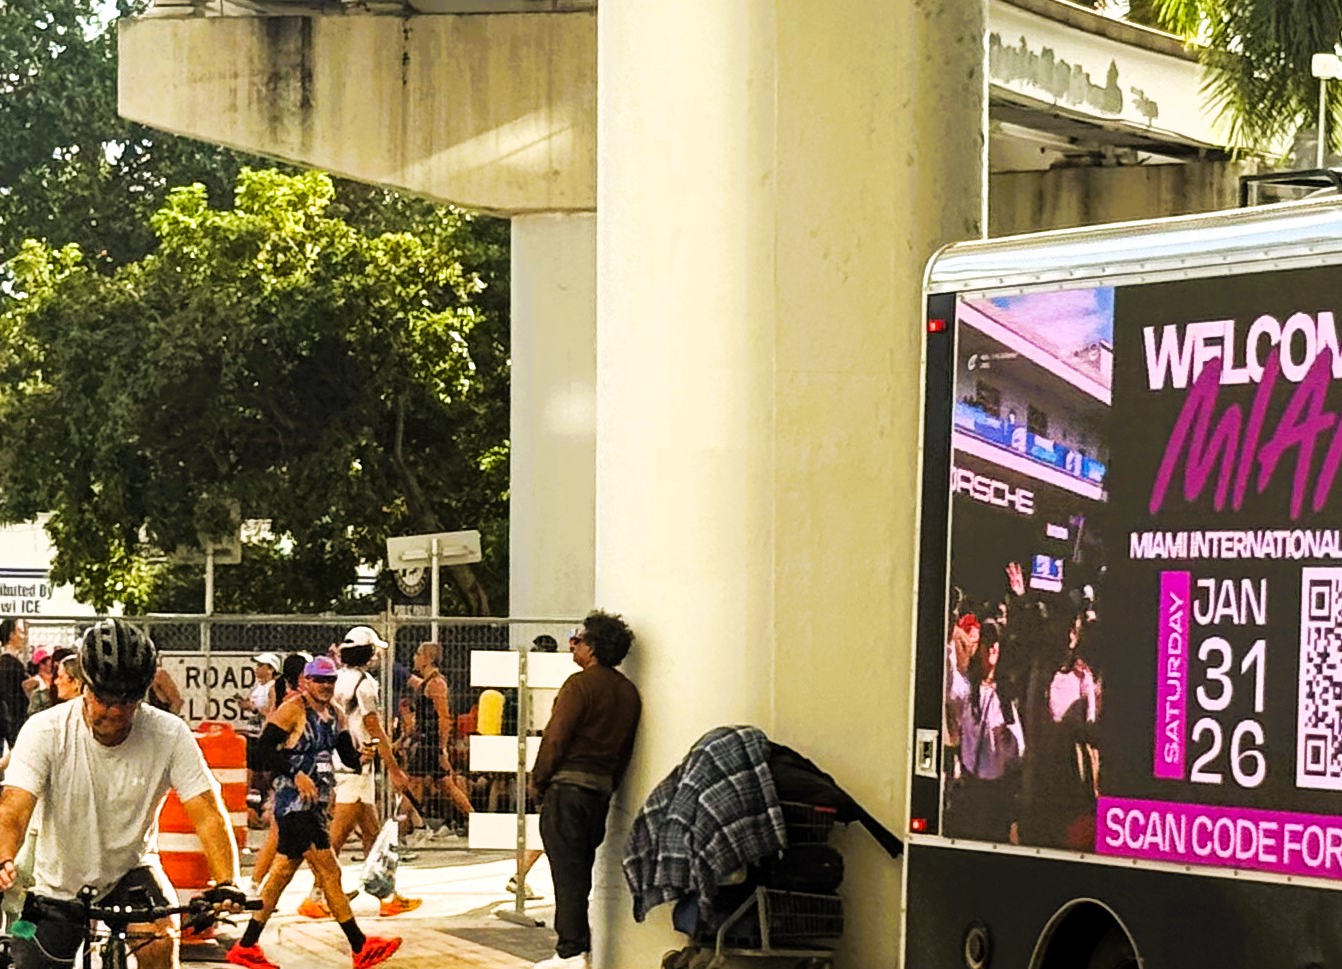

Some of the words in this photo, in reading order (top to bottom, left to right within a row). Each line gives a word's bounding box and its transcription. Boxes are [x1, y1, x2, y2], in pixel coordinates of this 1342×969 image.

[951, 465, 1034, 516] RSCHE
[1129, 531, 1188, 560] MIAMI
[21, 599, 41, 613] ICE
[39, 583, 54, 600] By
[1193, 577, 1267, 626] JAN
[185, 666, 256, 689] ROAD
[1163, 590, 1185, 765] SATURDAY
[1196, 636, 1266, 712] 31
[180, 698, 250, 721] LOSE
[1190, 717, 1267, 788] 26
[1105, 807, 1186, 854] SCAN
[1191, 815, 1278, 863] CODE
